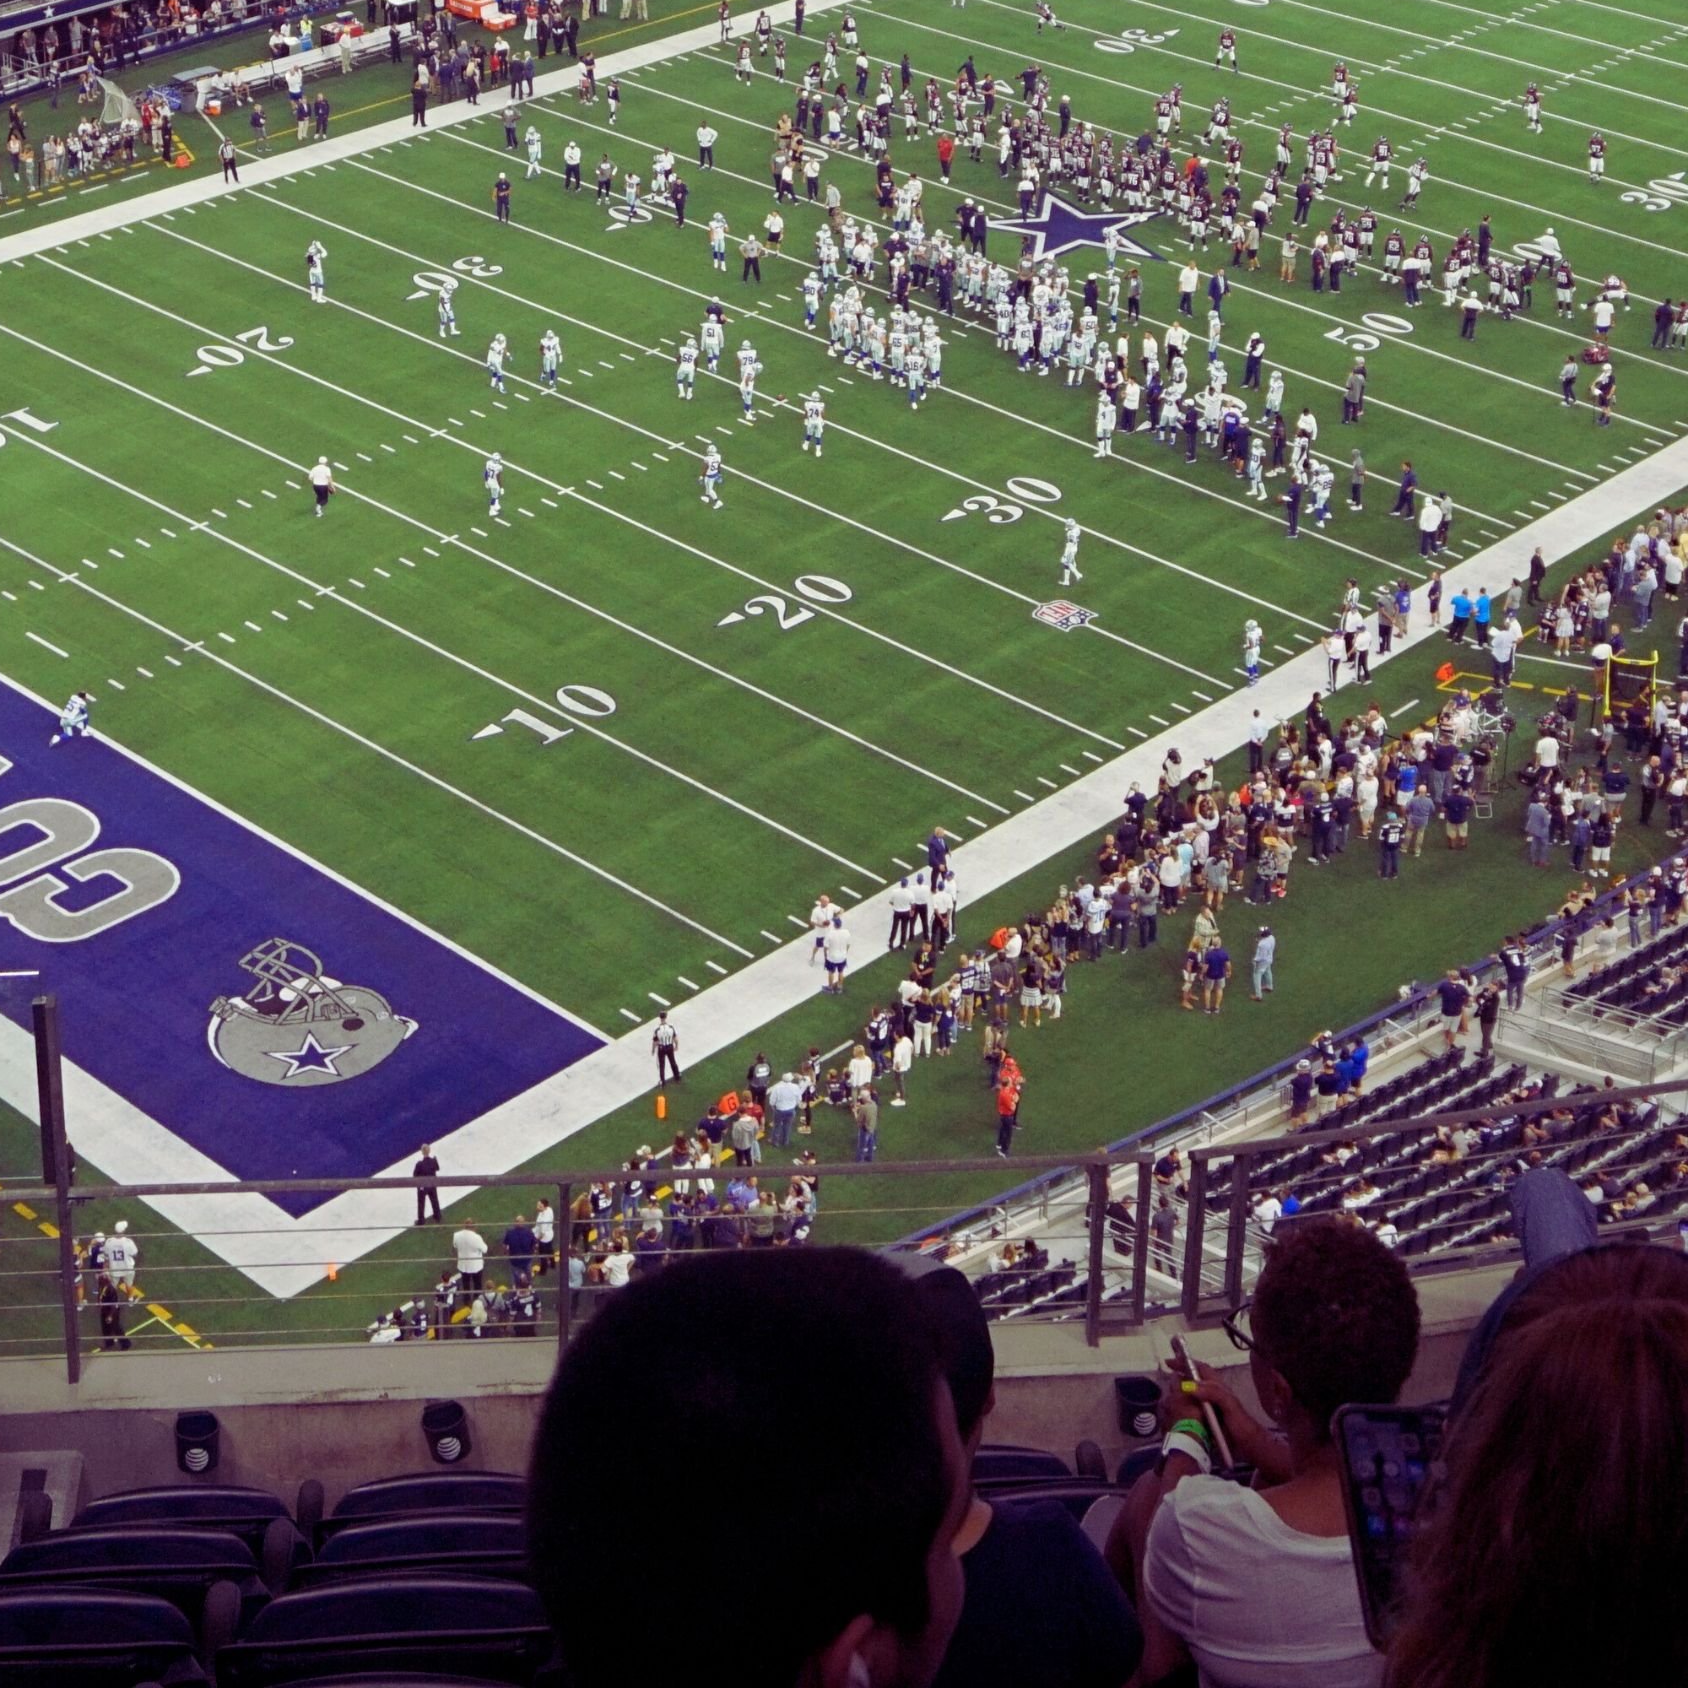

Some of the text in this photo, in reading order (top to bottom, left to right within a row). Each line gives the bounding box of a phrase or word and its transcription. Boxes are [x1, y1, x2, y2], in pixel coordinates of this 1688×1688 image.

[1093, 27, 1165, 54] 30
[412, 255, 504, 293] 30
[195, 325, 296, 369] 20
[1323, 312, 1415, 352] 50
[963, 476, 1063, 524] 30
[743, 575, 854, 631] 20
[500, 684, 617, 745] 10
